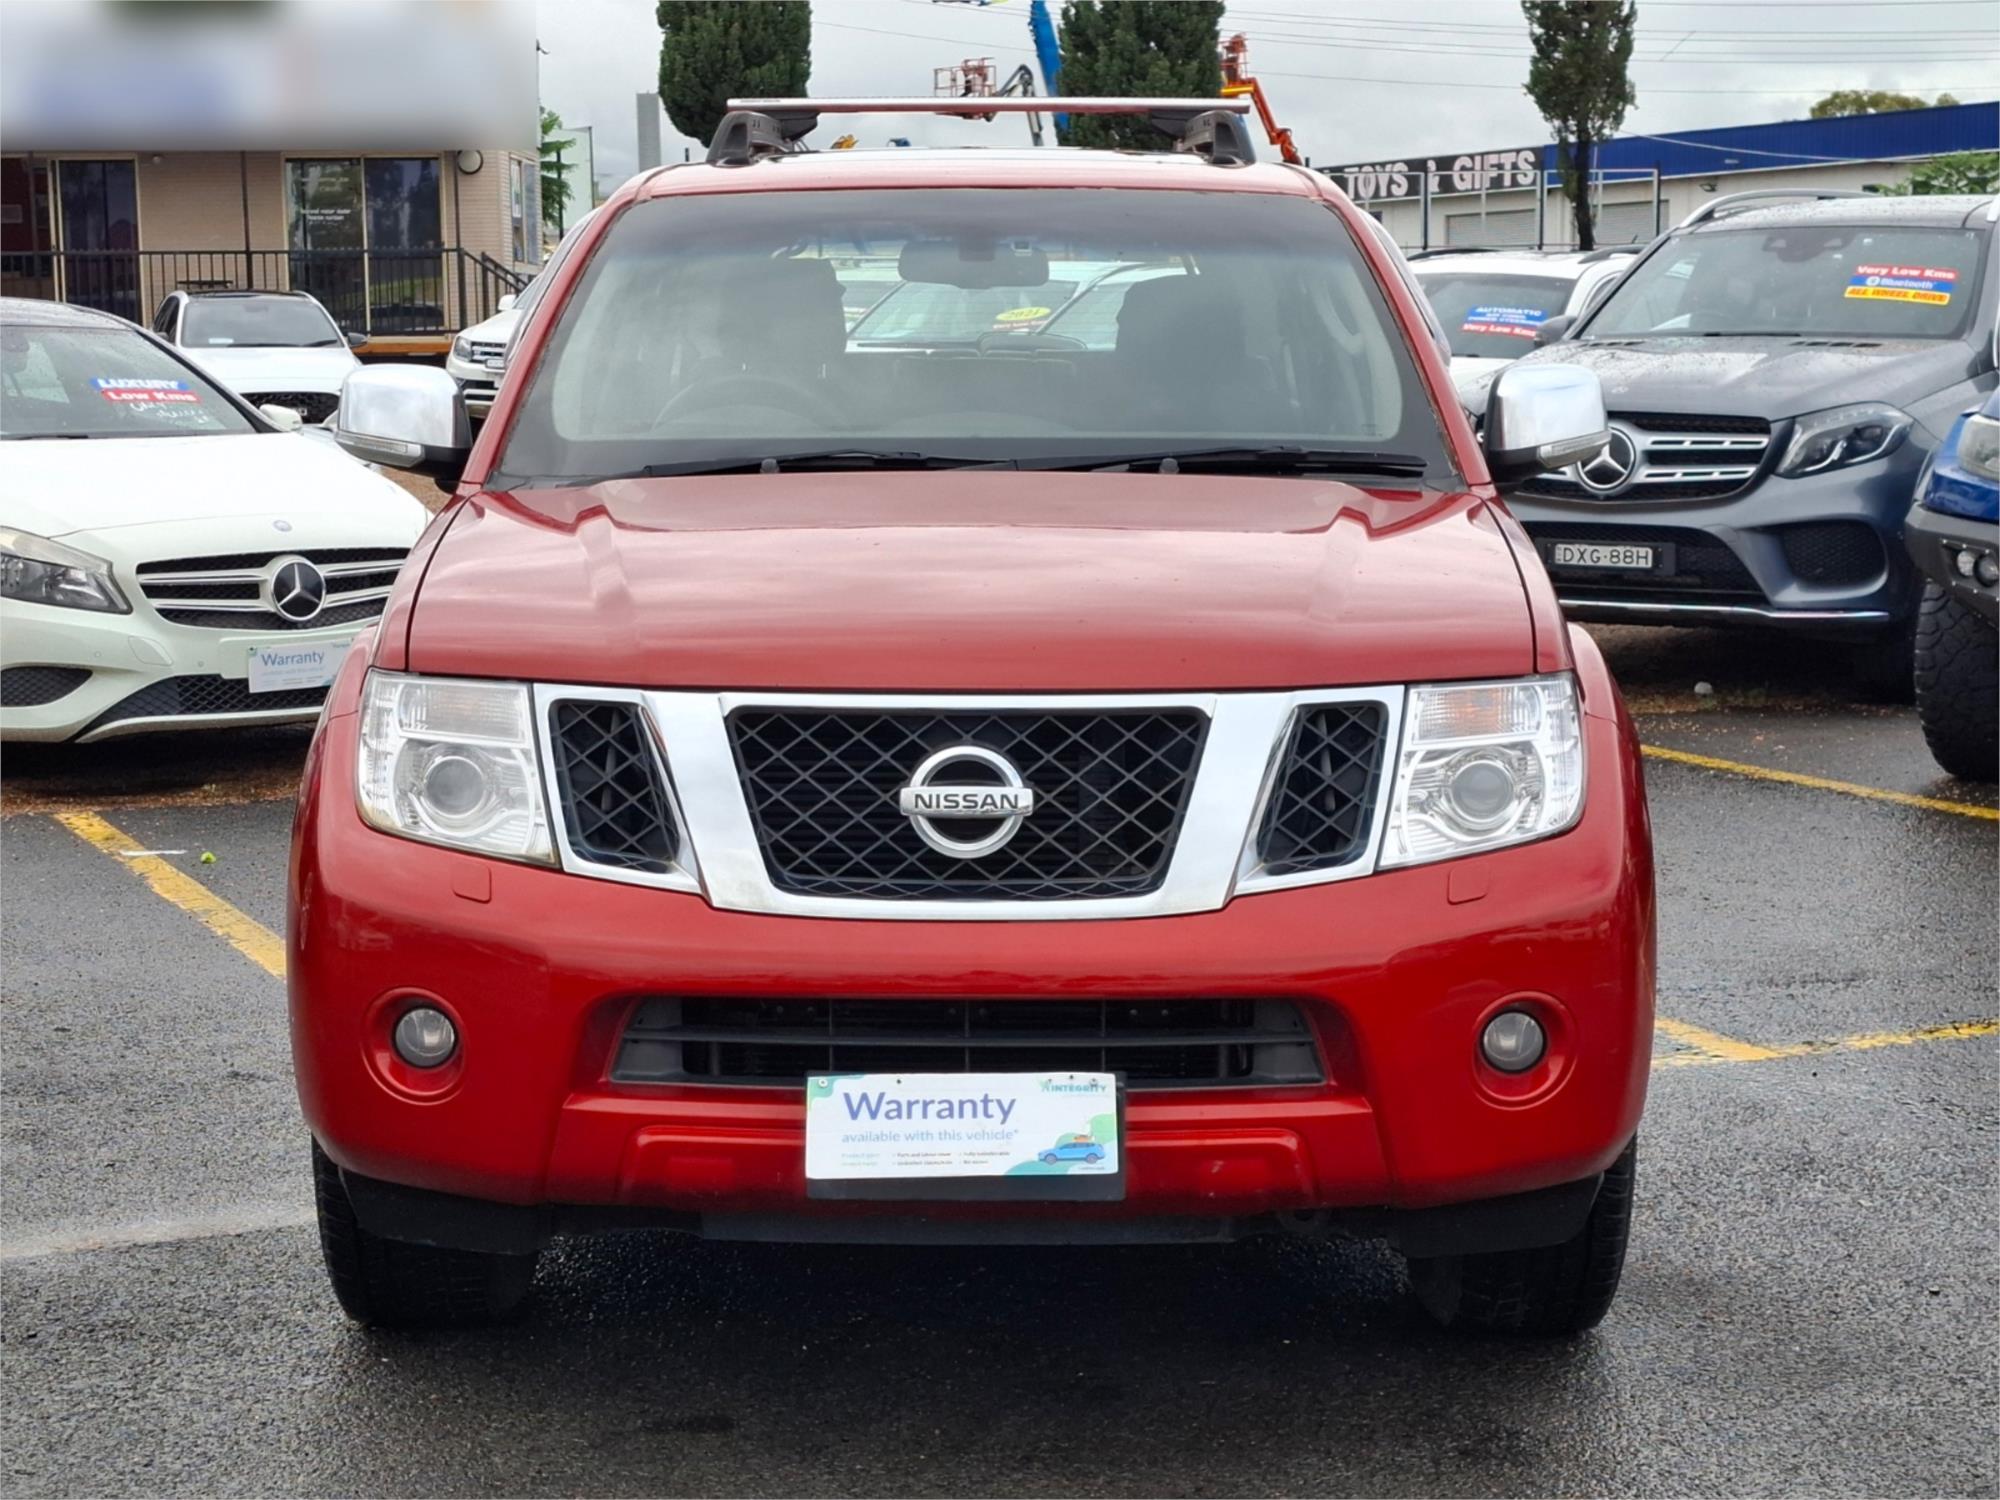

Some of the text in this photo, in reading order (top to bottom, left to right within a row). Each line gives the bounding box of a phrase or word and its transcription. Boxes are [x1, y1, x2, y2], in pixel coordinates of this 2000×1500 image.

[1344, 162, 1409, 199] TOYS
[1452, 150, 1536, 191] GIFTS
[1858, 265, 1956, 280] Very Low Kms
[1880, 277, 1934, 290] Bluetooth
[1848, 287, 1868, 297] ALL
[1475, 306, 1542, 317] AUTOMATIC
[1462, 322, 1488, 333] Very
[1489, 323, 1512, 333] Low
[97, 378, 179, 390] LUXURY
[106, 391, 198, 401] Low Kms
[261, 651, 325, 666] Warranty
[914, 793, 1019, 809] NISSAN
[843, 1092, 1017, 1125] Warranty
[841, 1129, 900, 1144] available
[904, 1128, 934, 1143] with
[938, 1127, 963, 1142] this
